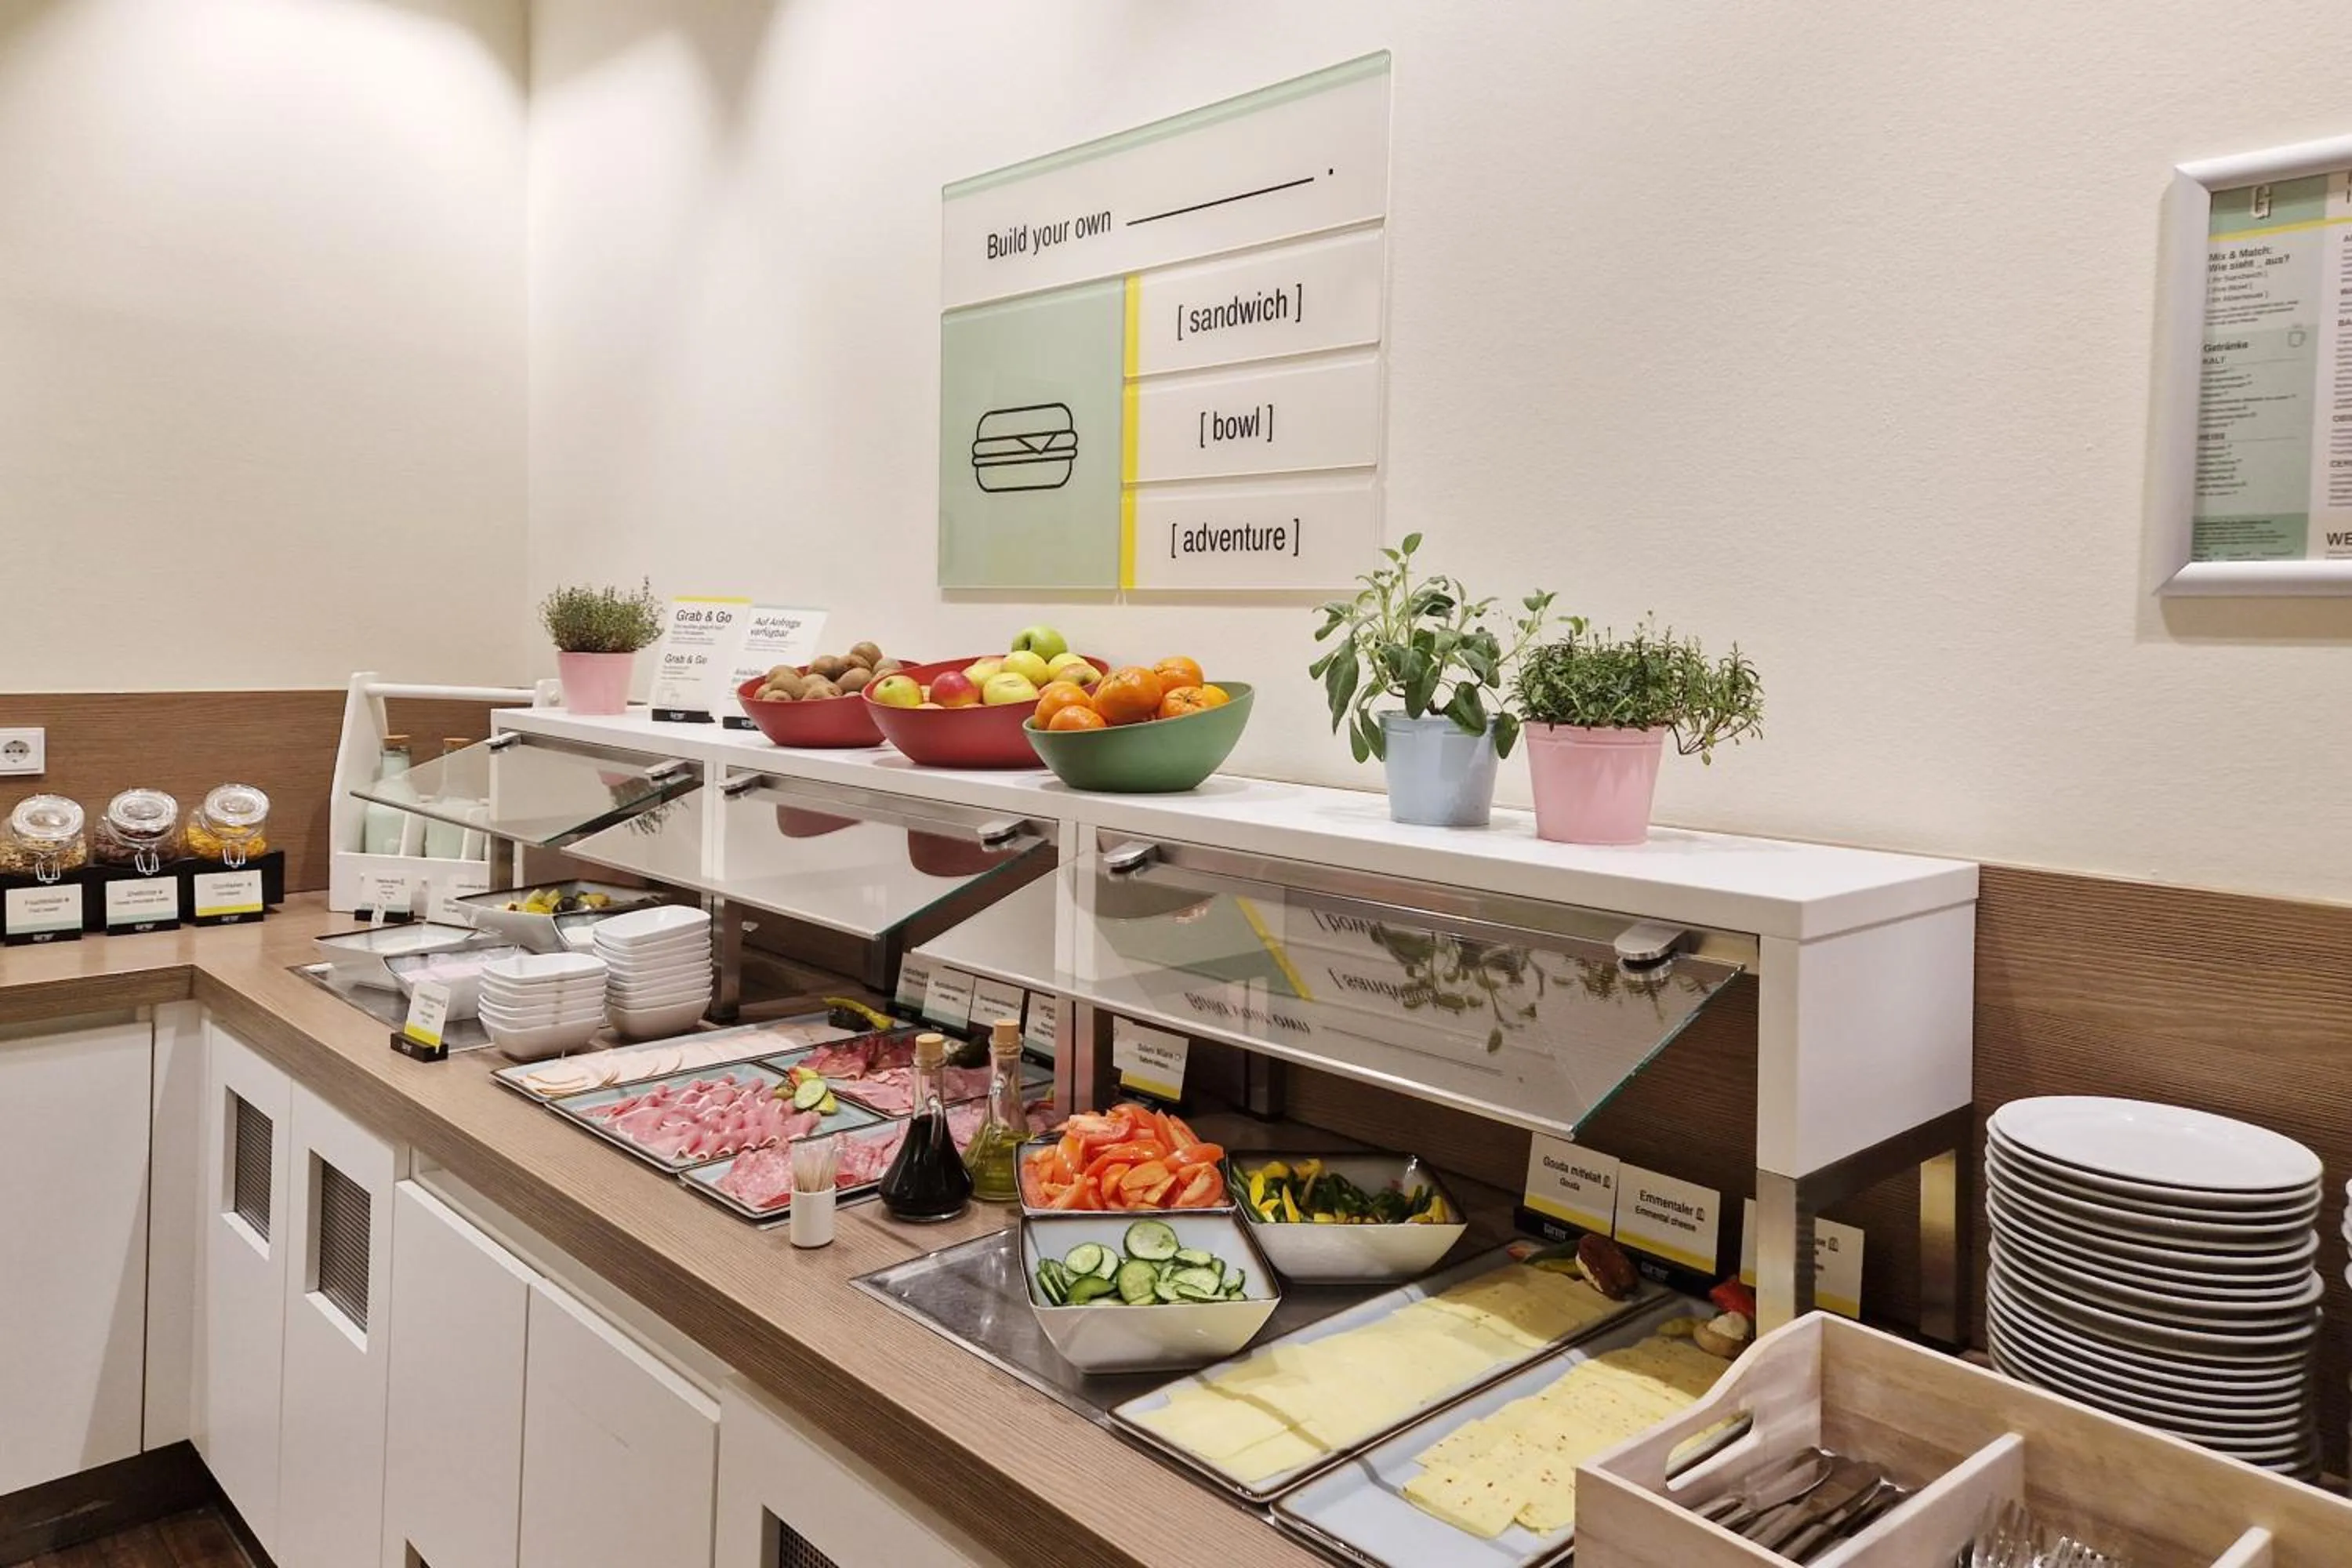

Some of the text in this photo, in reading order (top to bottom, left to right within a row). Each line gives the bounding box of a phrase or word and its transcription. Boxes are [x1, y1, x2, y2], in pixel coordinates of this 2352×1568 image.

[987, 210, 1112, 260] Build your own
[1189, 287, 1288, 333] sandwich
[1213, 405, 1260, 441] bowl
[1183, 521, 1286, 553] adventure
[676, 609, 733, 623] Grab & Go
[664, 653, 685, 664] Grab
[1639, 1189, 1694, 1216] Emmentaler
